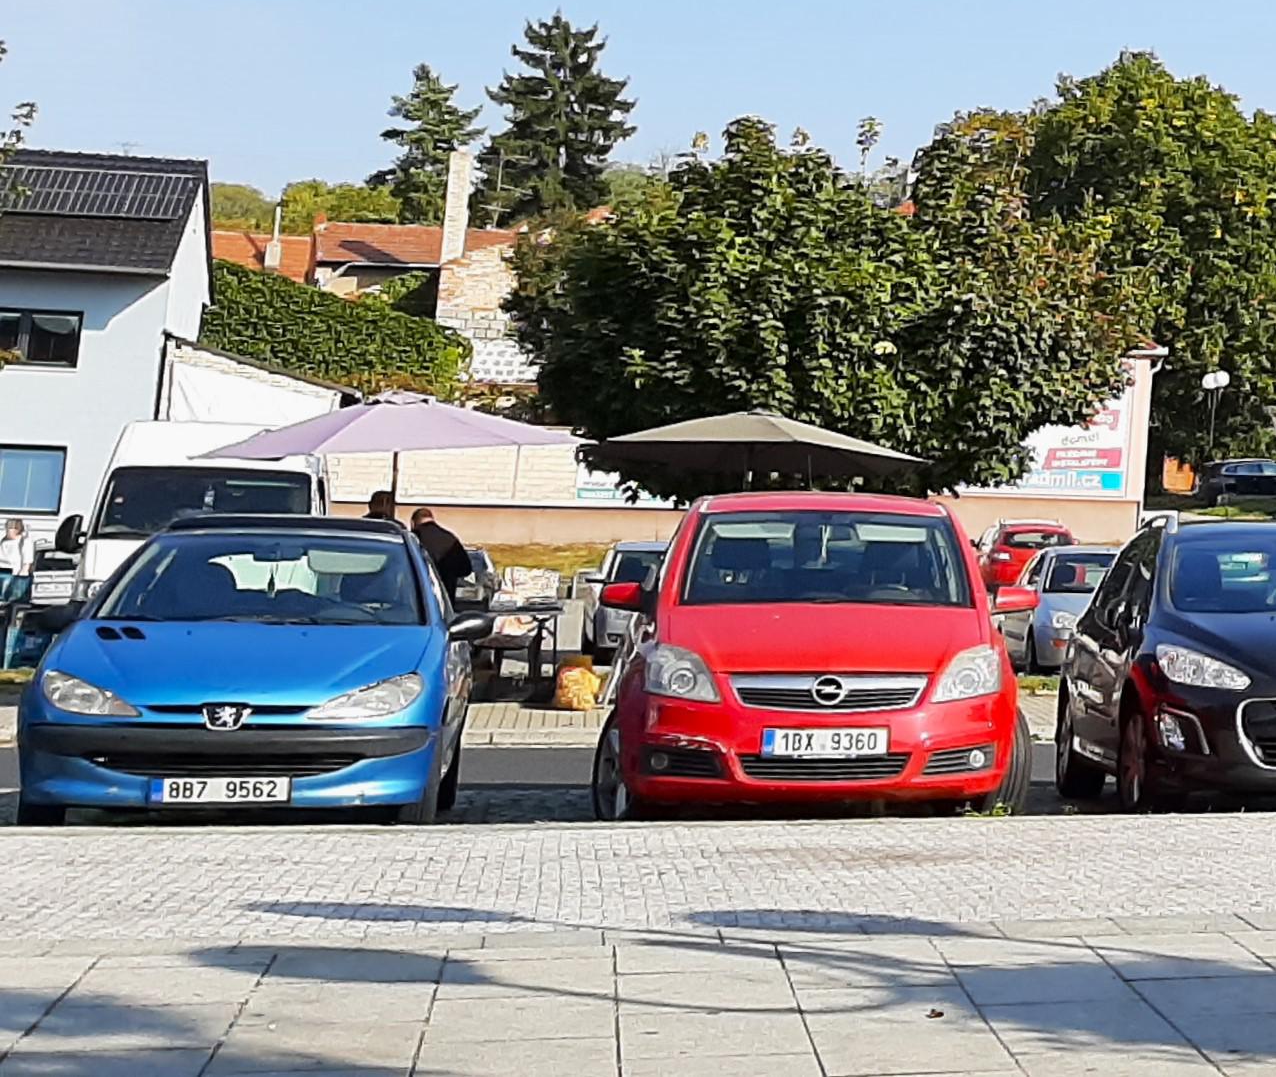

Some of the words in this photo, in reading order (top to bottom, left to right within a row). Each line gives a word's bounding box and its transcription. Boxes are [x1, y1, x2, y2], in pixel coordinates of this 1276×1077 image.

[781, 732, 814, 752] 1BX
[830, 732, 877, 751] 9360
[168, 780, 208, 799] 8B7
[224, 779, 278, 799] 9562
